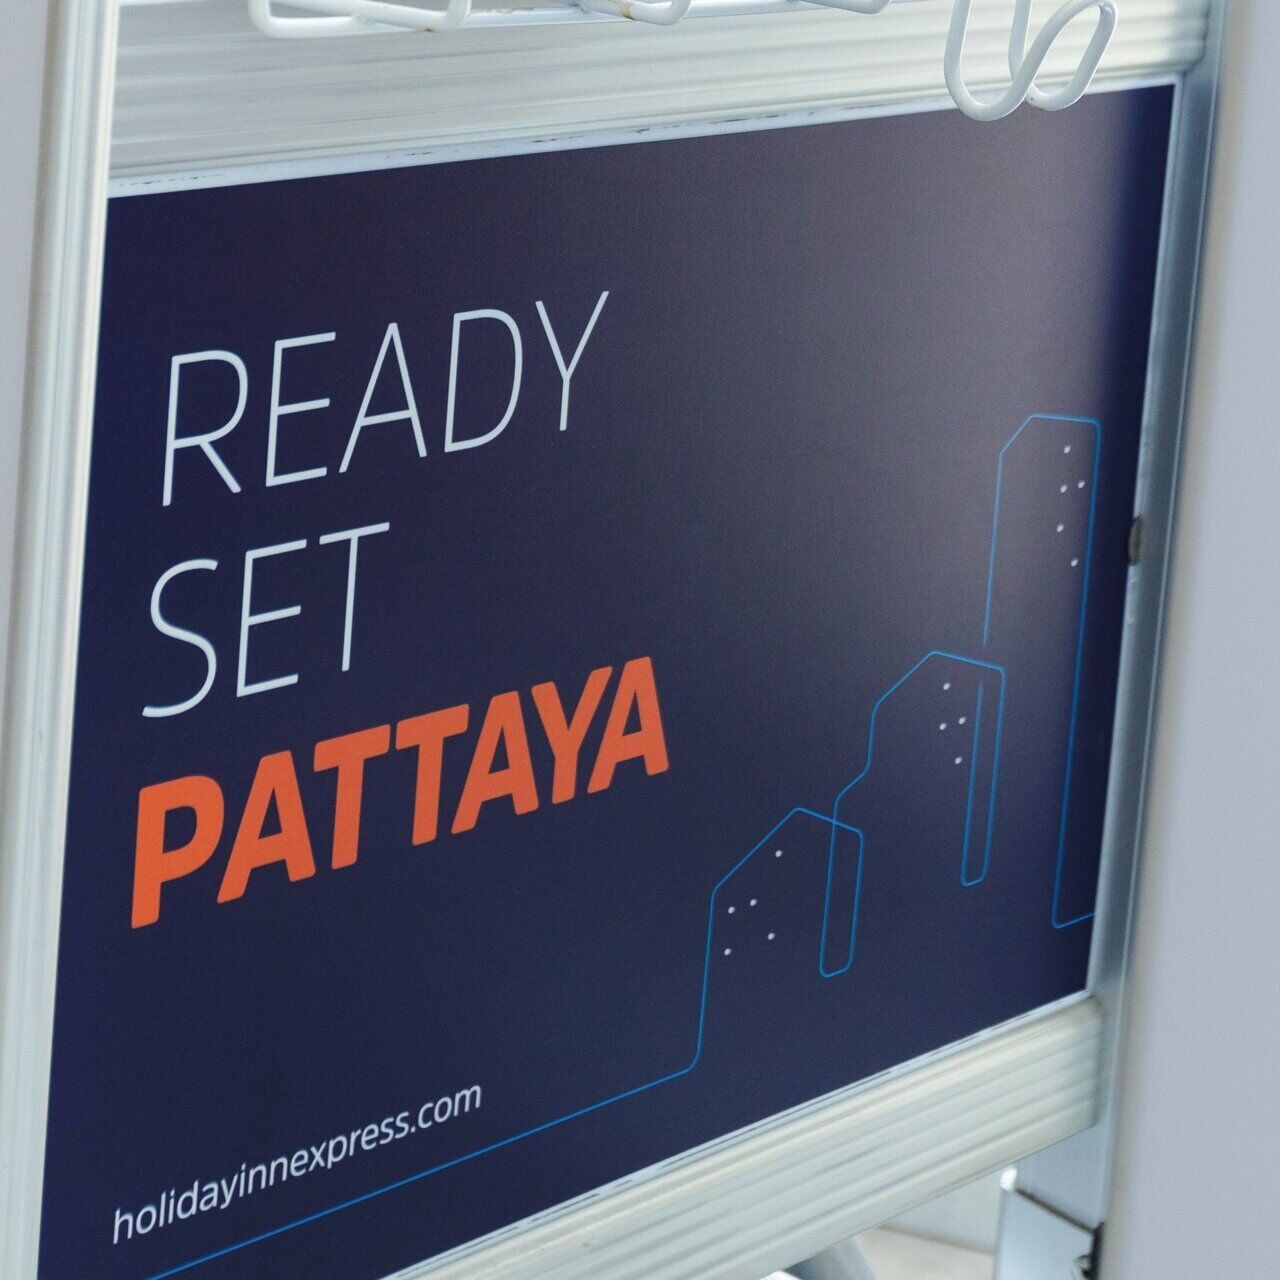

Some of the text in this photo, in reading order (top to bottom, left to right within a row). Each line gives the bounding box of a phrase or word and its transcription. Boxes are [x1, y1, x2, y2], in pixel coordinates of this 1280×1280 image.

[163, 290, 610, 507] READY
[142, 522, 390, 718] SET
[131, 655, 669, 930] PATTAYA
[112, 1084, 482, 1245] holidayinnexpress.com
